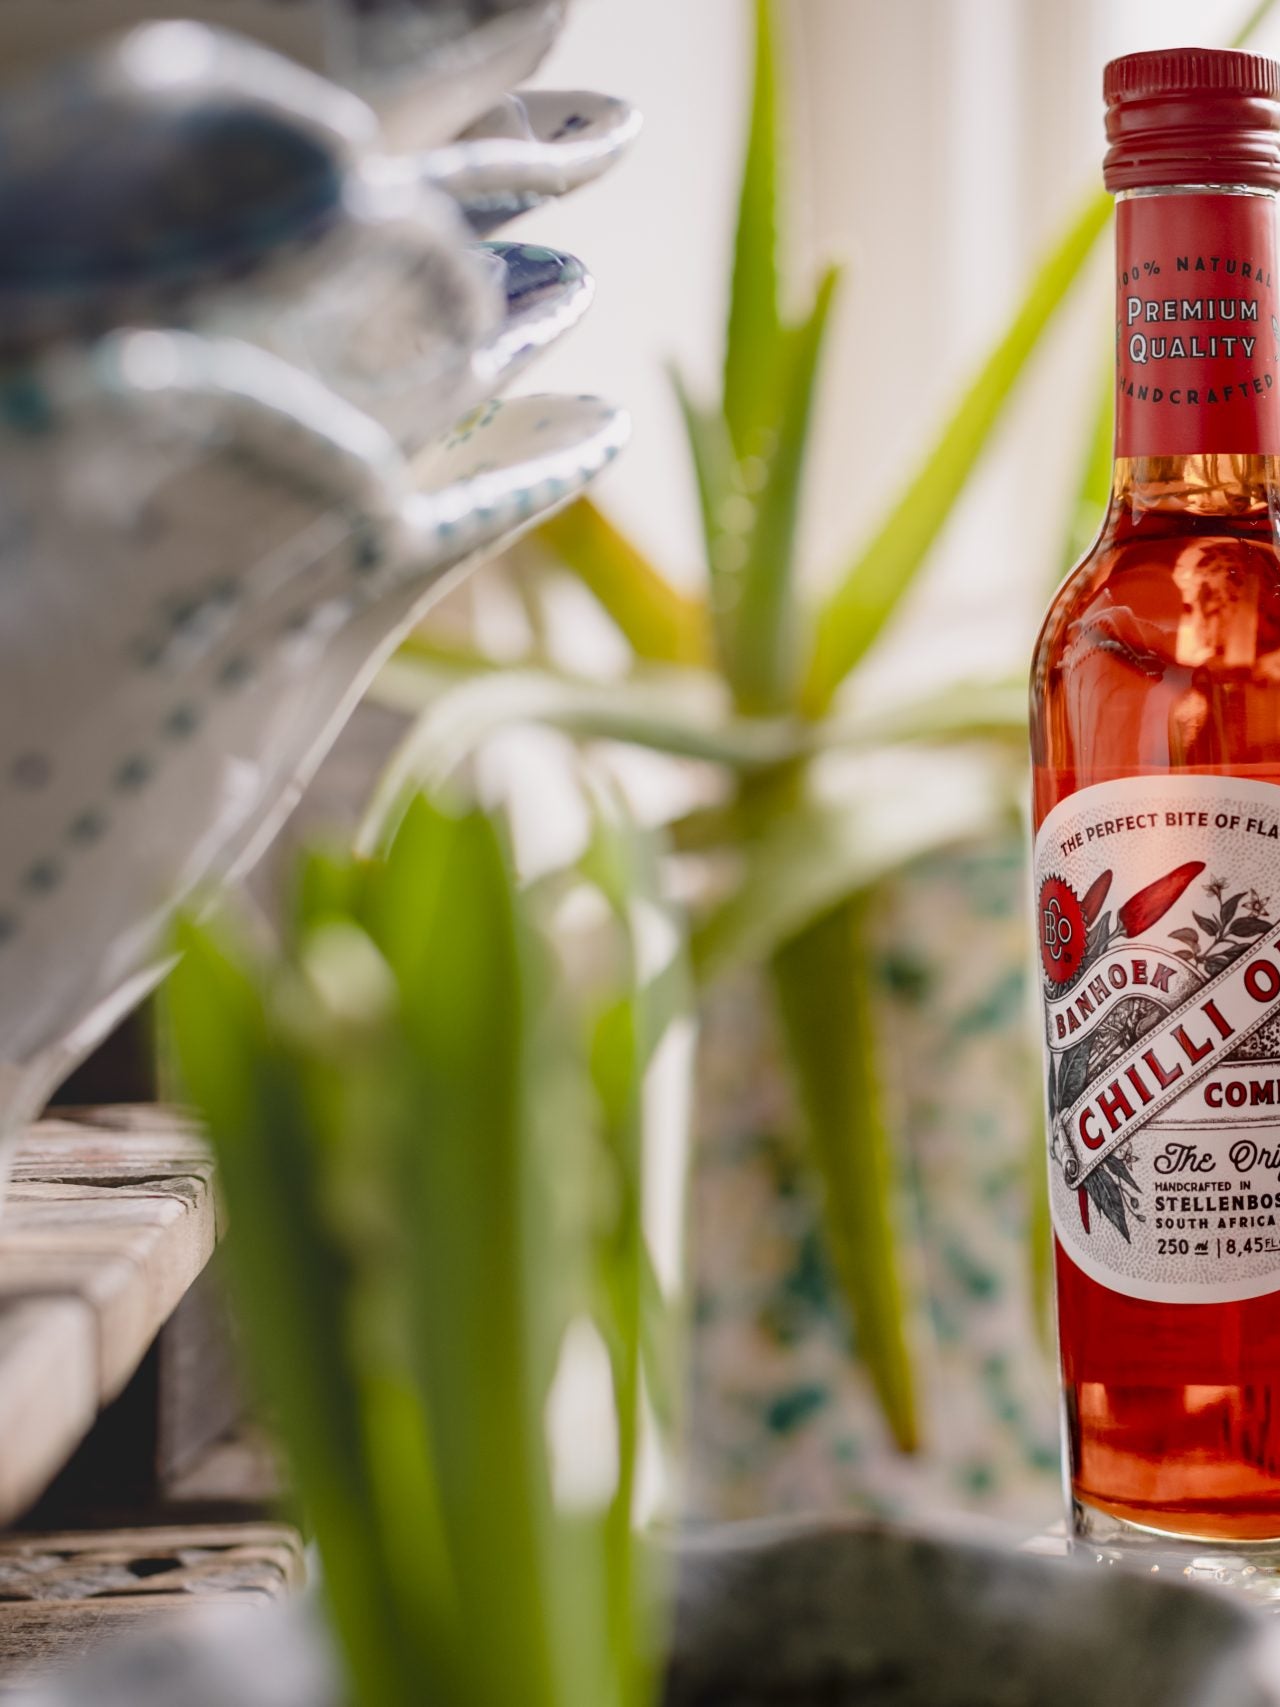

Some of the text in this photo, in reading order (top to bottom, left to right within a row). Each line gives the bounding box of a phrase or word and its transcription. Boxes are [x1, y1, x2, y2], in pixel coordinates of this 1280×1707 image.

[1176, 256, 1272, 288] NATURAL
[1126, 296, 1259, 326] PREMIUM
[1129, 333, 1257, 364] QUALITY
[1119, 373, 1274, 405] HANDCRAFTED
[1060, 832, 1084, 858] THE
[1085, 812, 1158, 843] PERFECT
[1165, 811, 1208, 827] BITE
[1214, 813, 1241, 829] OF
[1055, 958, 1178, 1040] BANHOEK
[1078, 998, 1236, 1151] CHILLI
[1153, 1142, 1217, 1175] The
[1154, 1180, 1251, 1192] HANDCRAFTED IN
[1155, 1214, 1276, 1229] SOUTH AFRICA
[1157, 1238, 1189, 1255] 250
